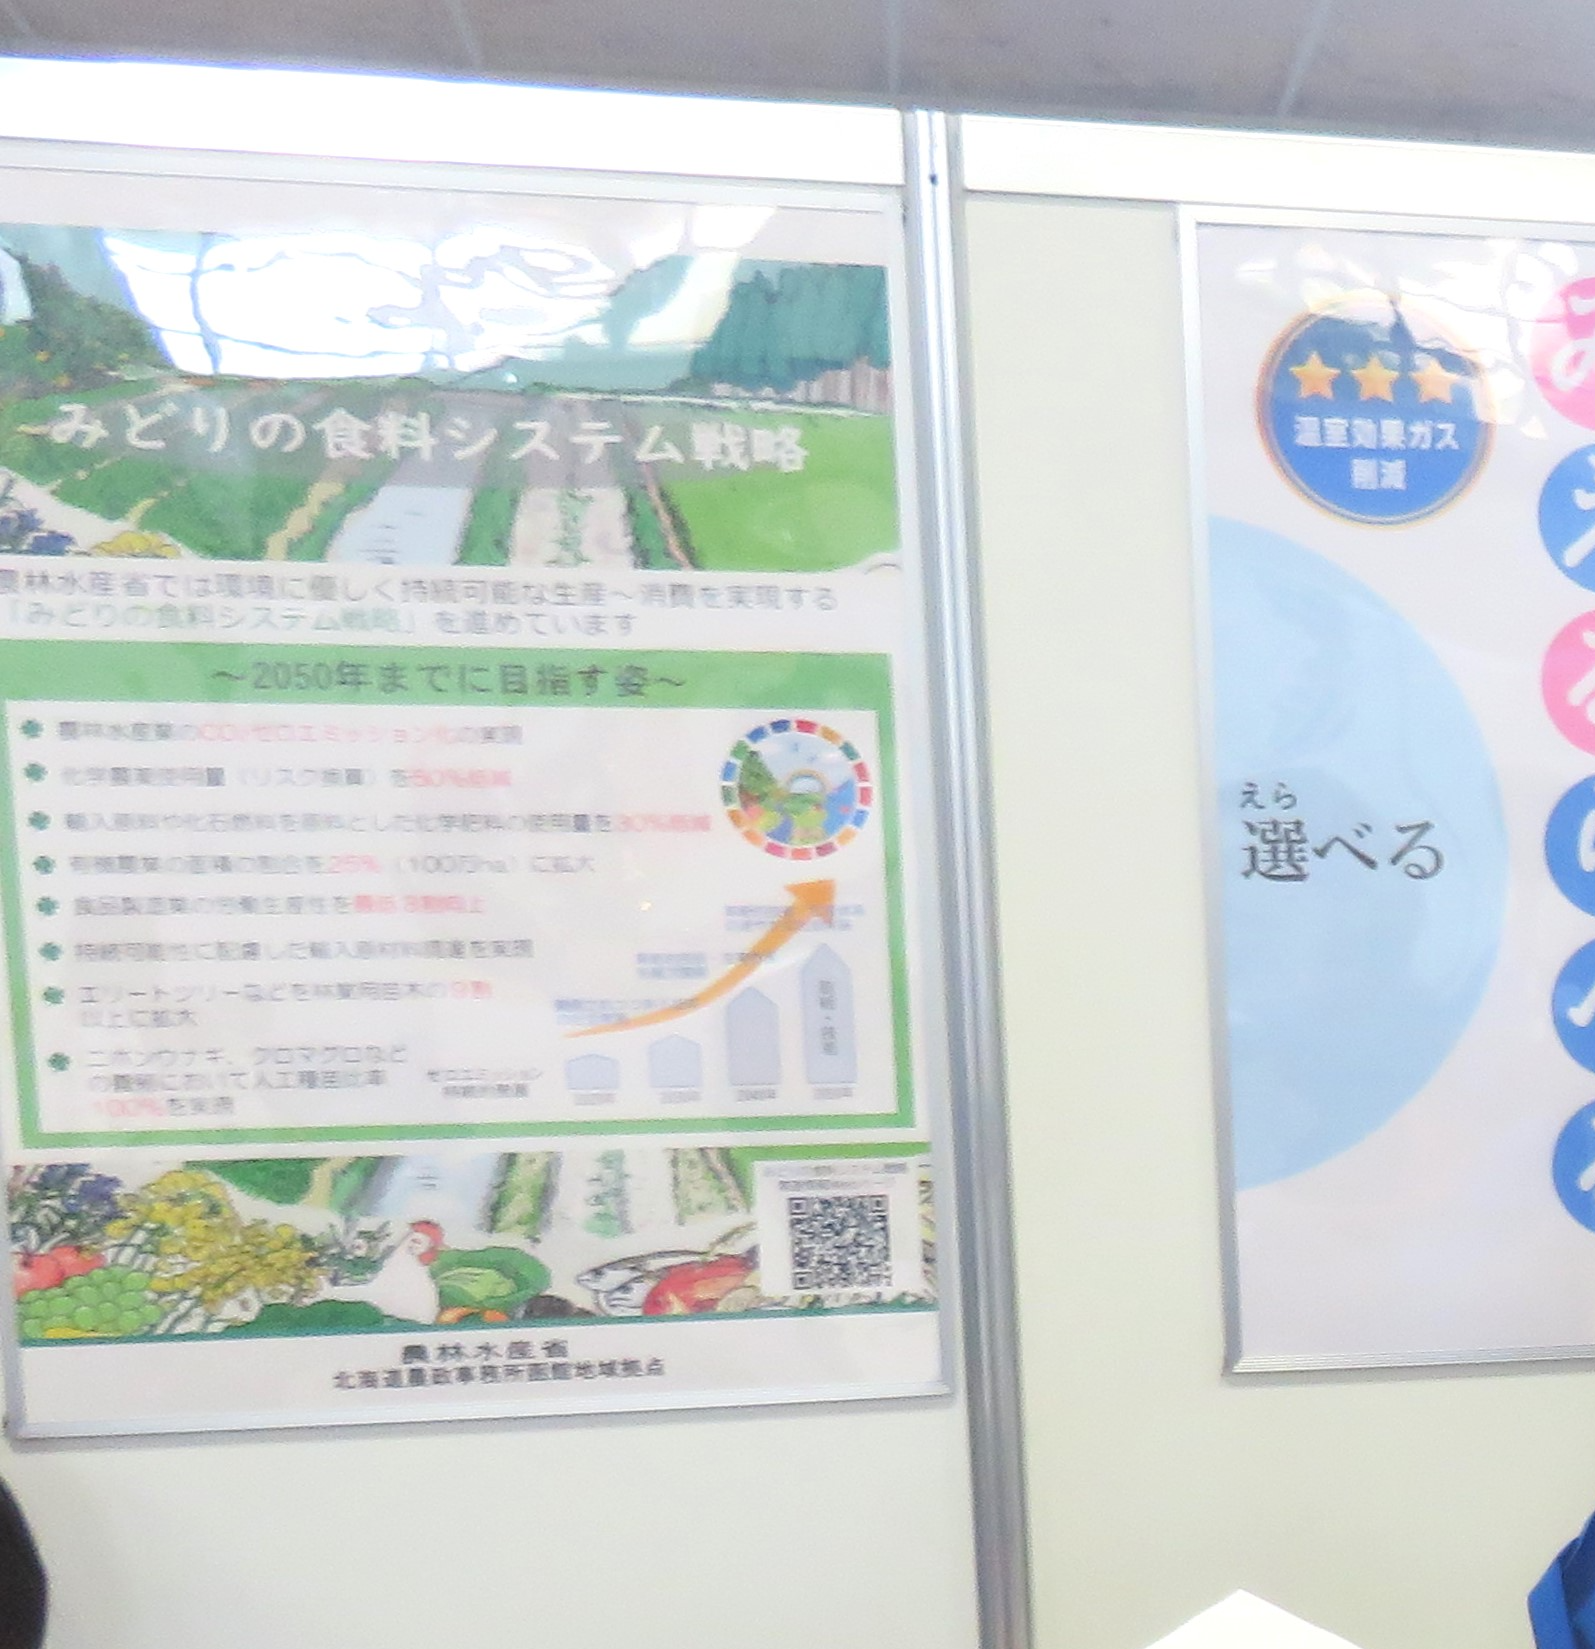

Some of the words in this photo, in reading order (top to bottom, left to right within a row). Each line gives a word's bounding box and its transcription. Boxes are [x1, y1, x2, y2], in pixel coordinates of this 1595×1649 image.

[48, 402, 810, 472] みどりの食料システム戦略
[1294, 416, 1460, 452] 温室効果ガス
[1239, 780, 1299, 811] えら
[1240, 818, 1446, 883] 選べる
